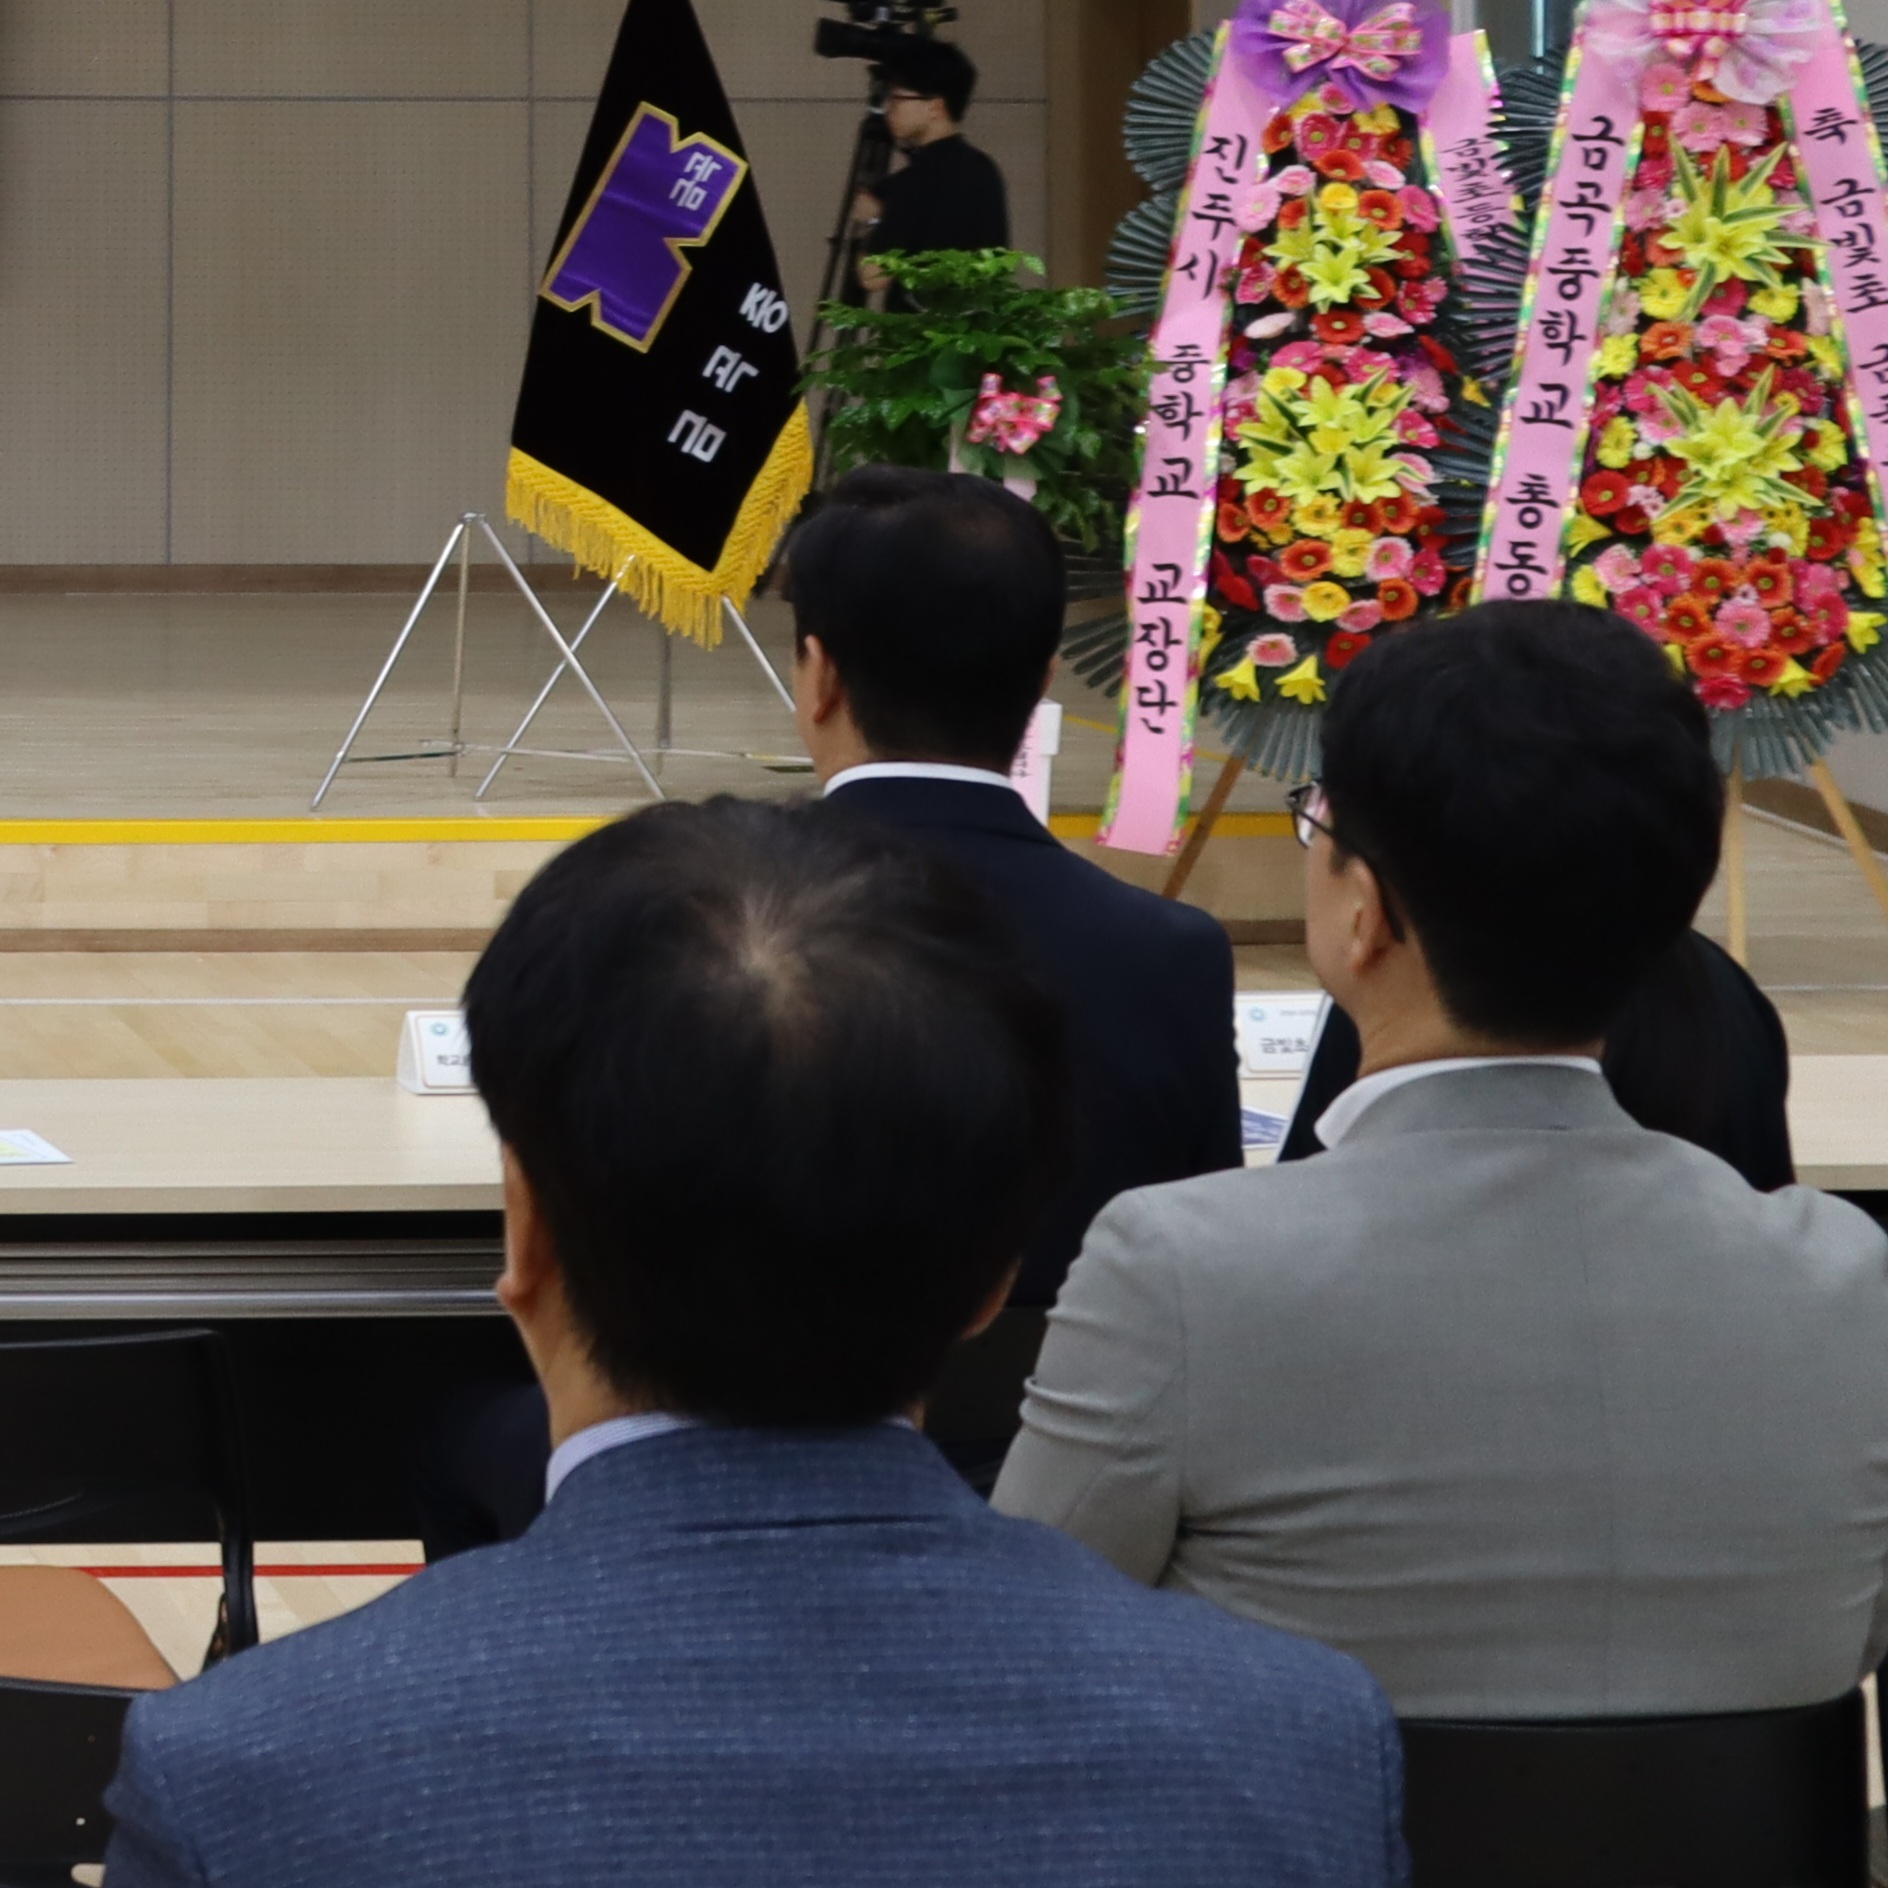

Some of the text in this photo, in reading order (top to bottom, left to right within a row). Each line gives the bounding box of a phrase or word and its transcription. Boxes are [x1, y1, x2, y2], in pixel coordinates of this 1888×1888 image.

[1175, 131, 1249, 302] 진주시
[1517, 113, 1626, 432] 금곡중학교
[1145, 338, 1212, 502] 중학교
[1131, 559, 1187, 738] 교장단
